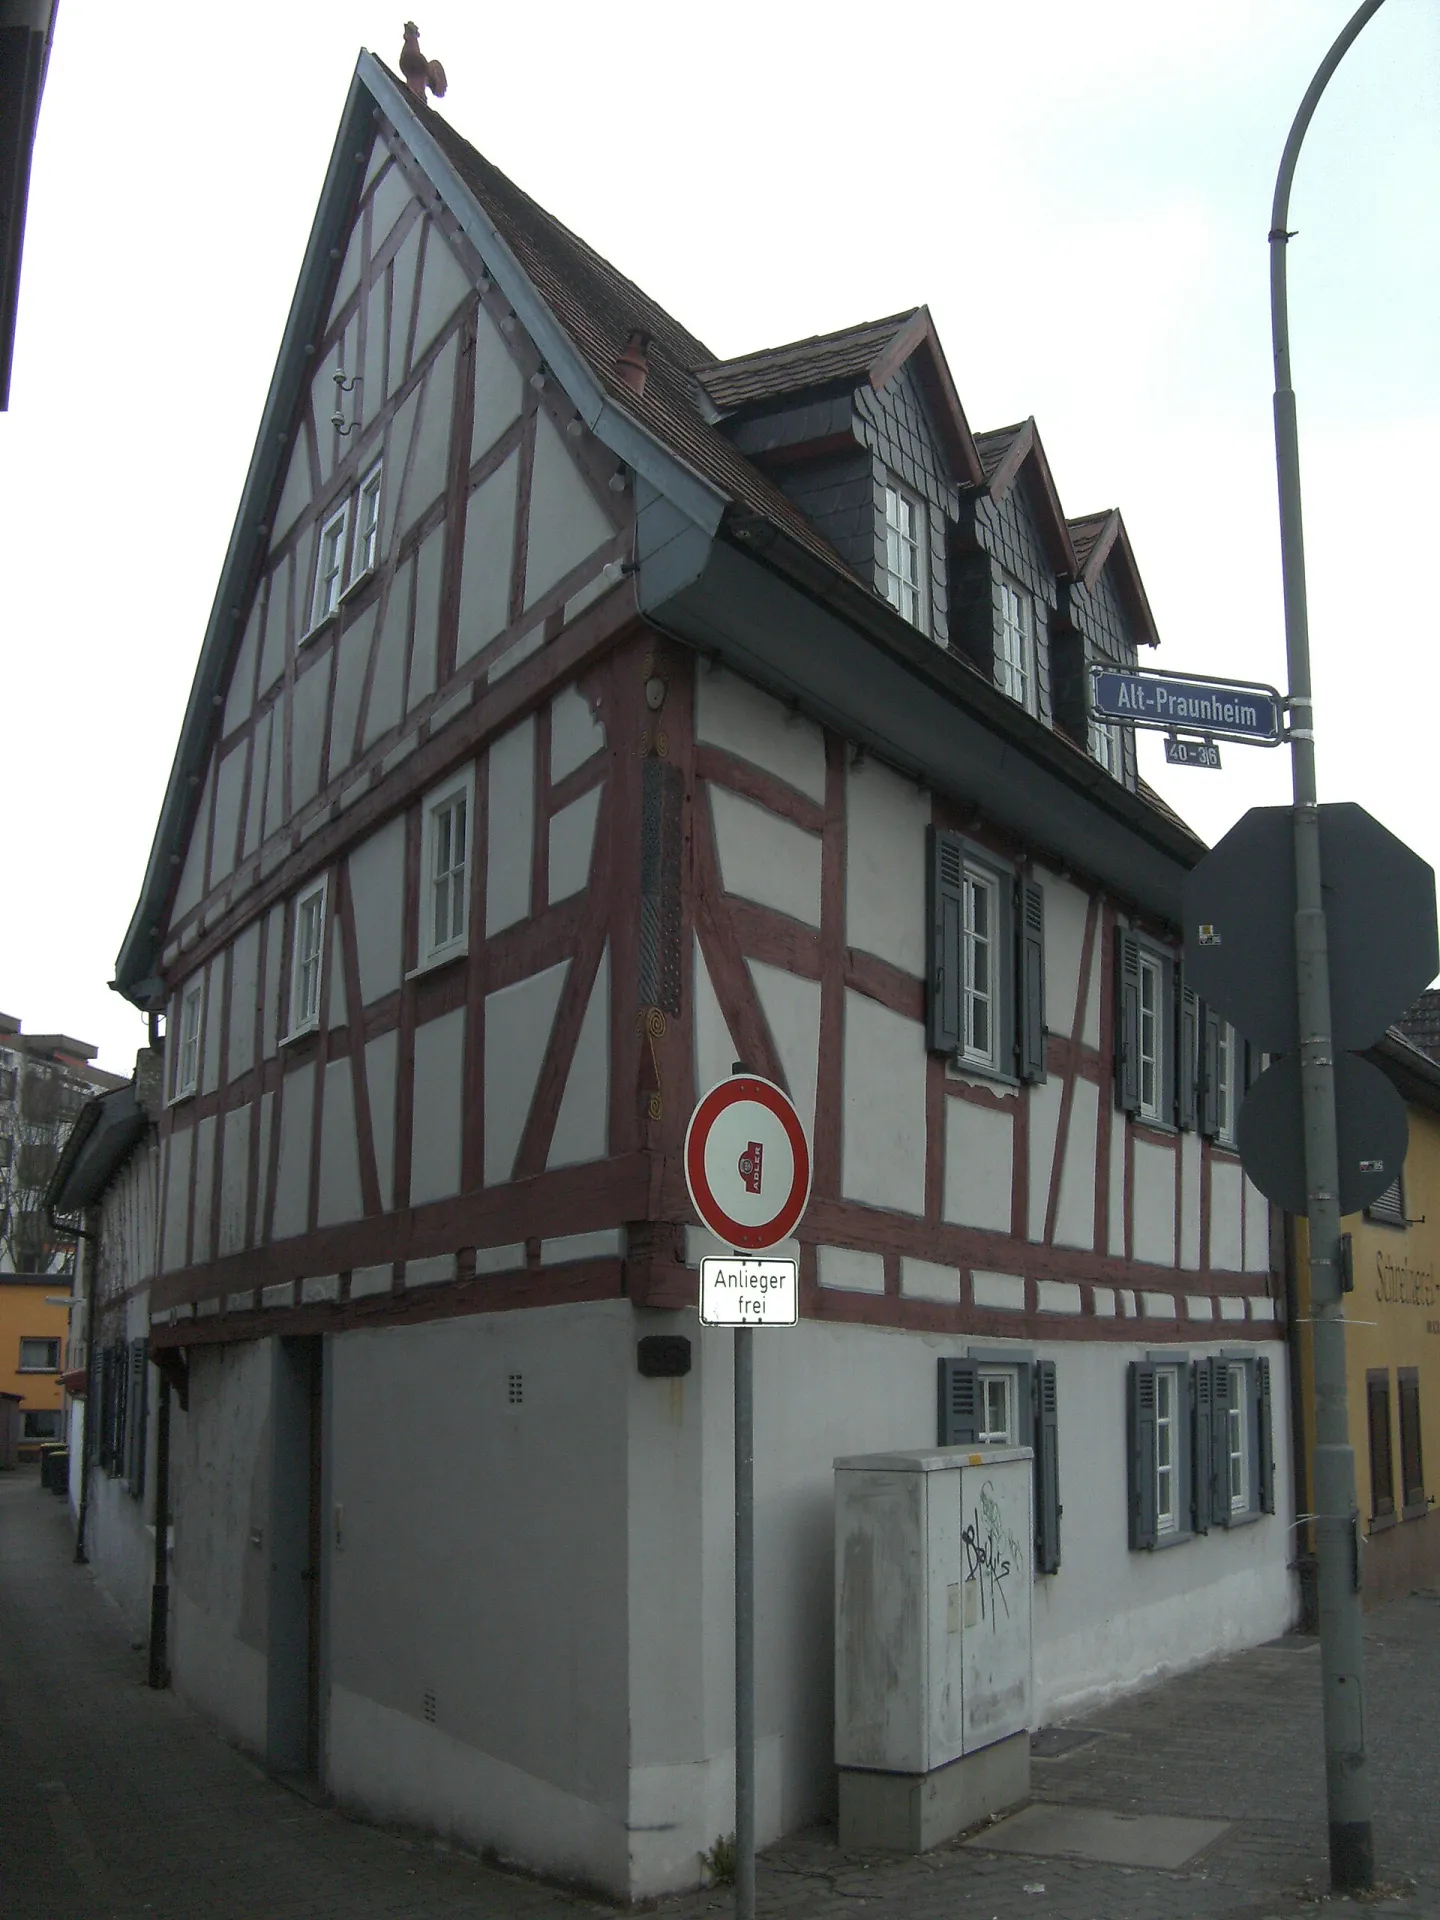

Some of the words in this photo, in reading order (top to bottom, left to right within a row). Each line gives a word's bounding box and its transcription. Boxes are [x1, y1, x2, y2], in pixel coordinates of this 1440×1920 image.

[1118, 682, 1257, 726] Alt-Praunheim
[753, 1146, 761, 1191] ADLER
[714, 1269, 786, 1293] Anlieger
[738, 1295, 766, 1314] frei
